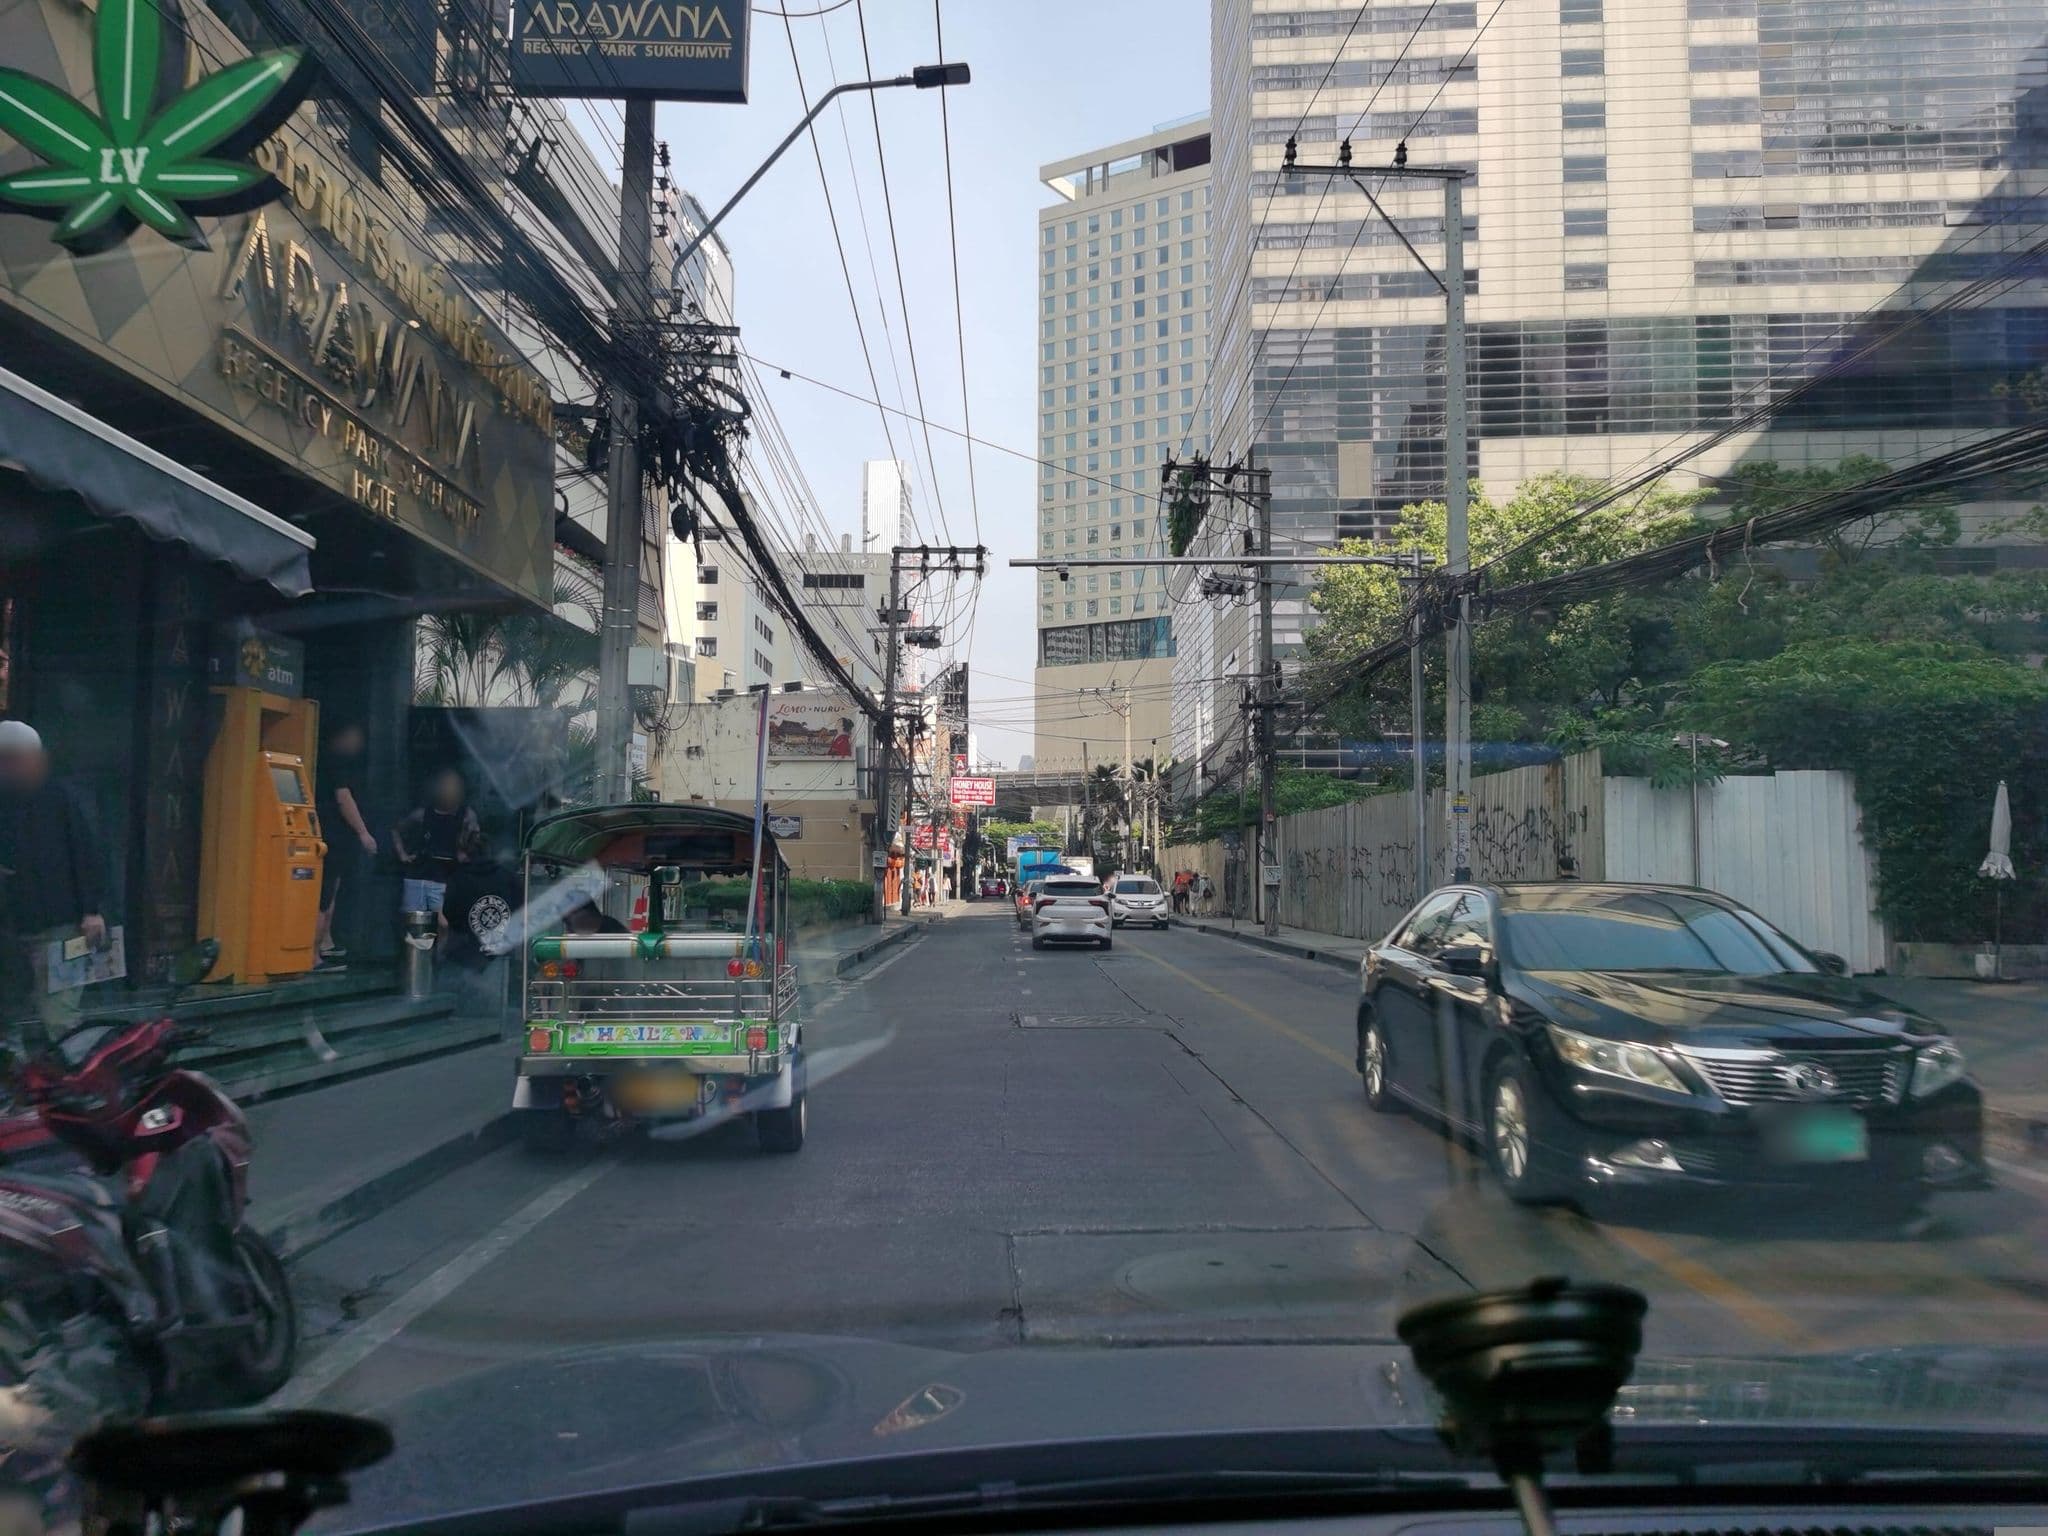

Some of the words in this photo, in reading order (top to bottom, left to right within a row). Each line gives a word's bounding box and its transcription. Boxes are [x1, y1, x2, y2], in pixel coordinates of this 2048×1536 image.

[522, 0, 732, 40] ARAWANA
[523, 42, 590, 56] REGENCY
[600, 44, 636, 57] PARK
[645, 45, 732, 59] SUKHUMVIT
[100, 146, 150, 184] LV
[345, 419, 393, 477] PARK
[267, 664, 295, 686] atm
[813, 705, 840, 714] NURU
[953, 781, 974, 790] HONEY
[975, 781, 993, 790] HOUSE
